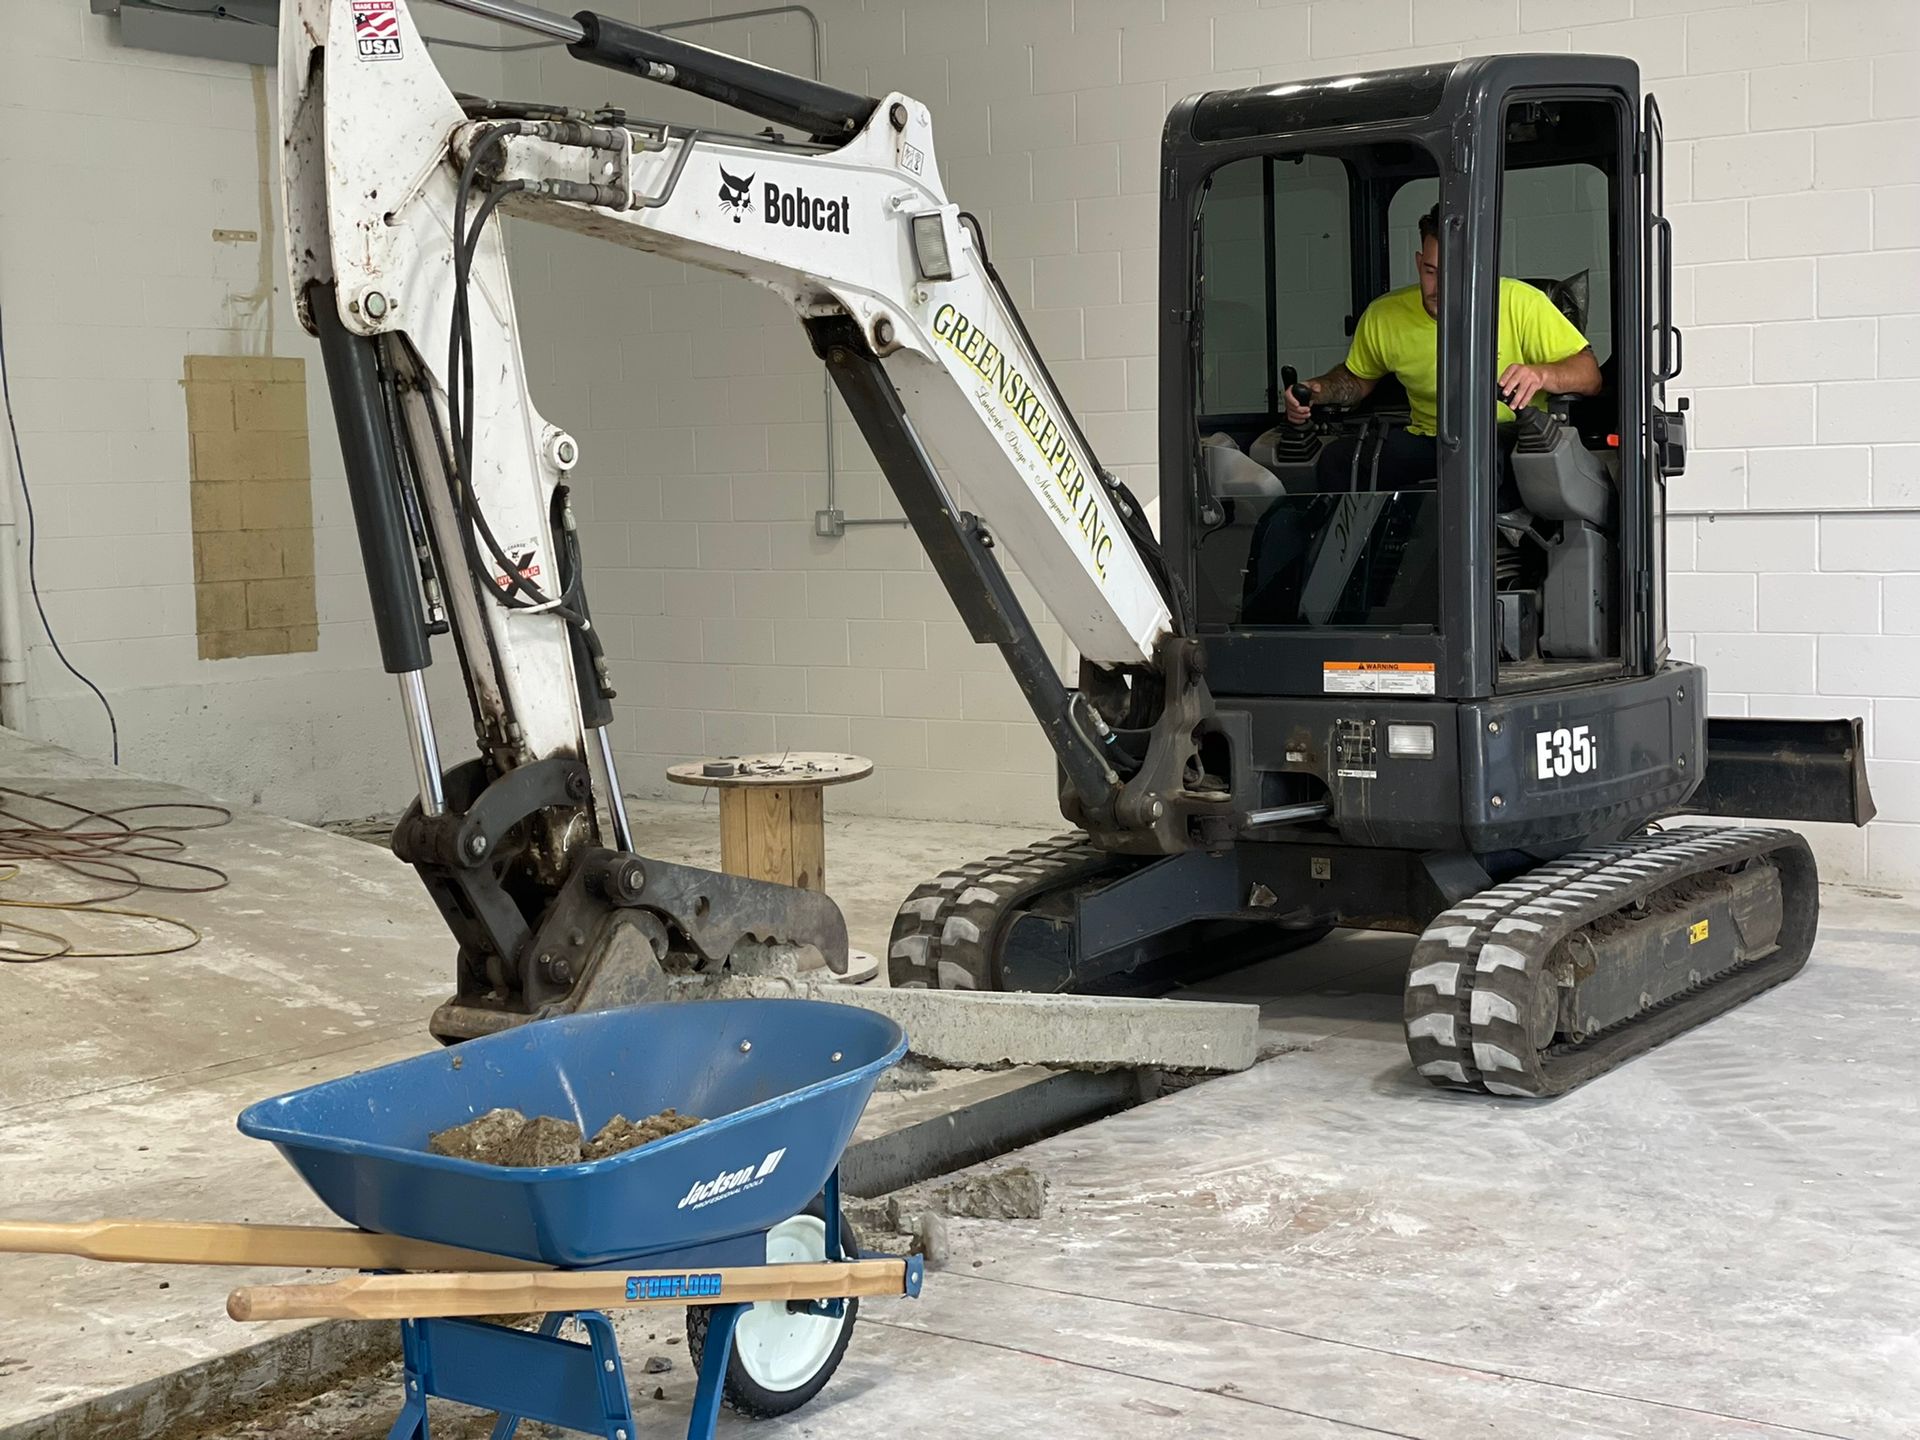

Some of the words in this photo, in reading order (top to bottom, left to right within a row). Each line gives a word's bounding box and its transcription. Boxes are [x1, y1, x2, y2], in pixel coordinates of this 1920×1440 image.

[360, 39, 399, 54] USA
[764, 182, 850, 235] Bobcat
[932, 303, 1085, 512] GREENSKEEPER
[1078, 493, 1112, 580] INC.
[975, 385, 1005, 430] Landscape
[1005, 430, 1027, 466] Design
[1034, 474, 1070, 525] Management
[497, 566, 540, 587] HYULIC
[1536, 725, 1597, 780] E35i
[677, 1164, 755, 1209] Jackson
[692, 1187, 742, 1211] PROFESSIONAL
[743, 1178, 764, 1191] TOOLS
[625, 1273, 722, 1299] STONFLOOR
